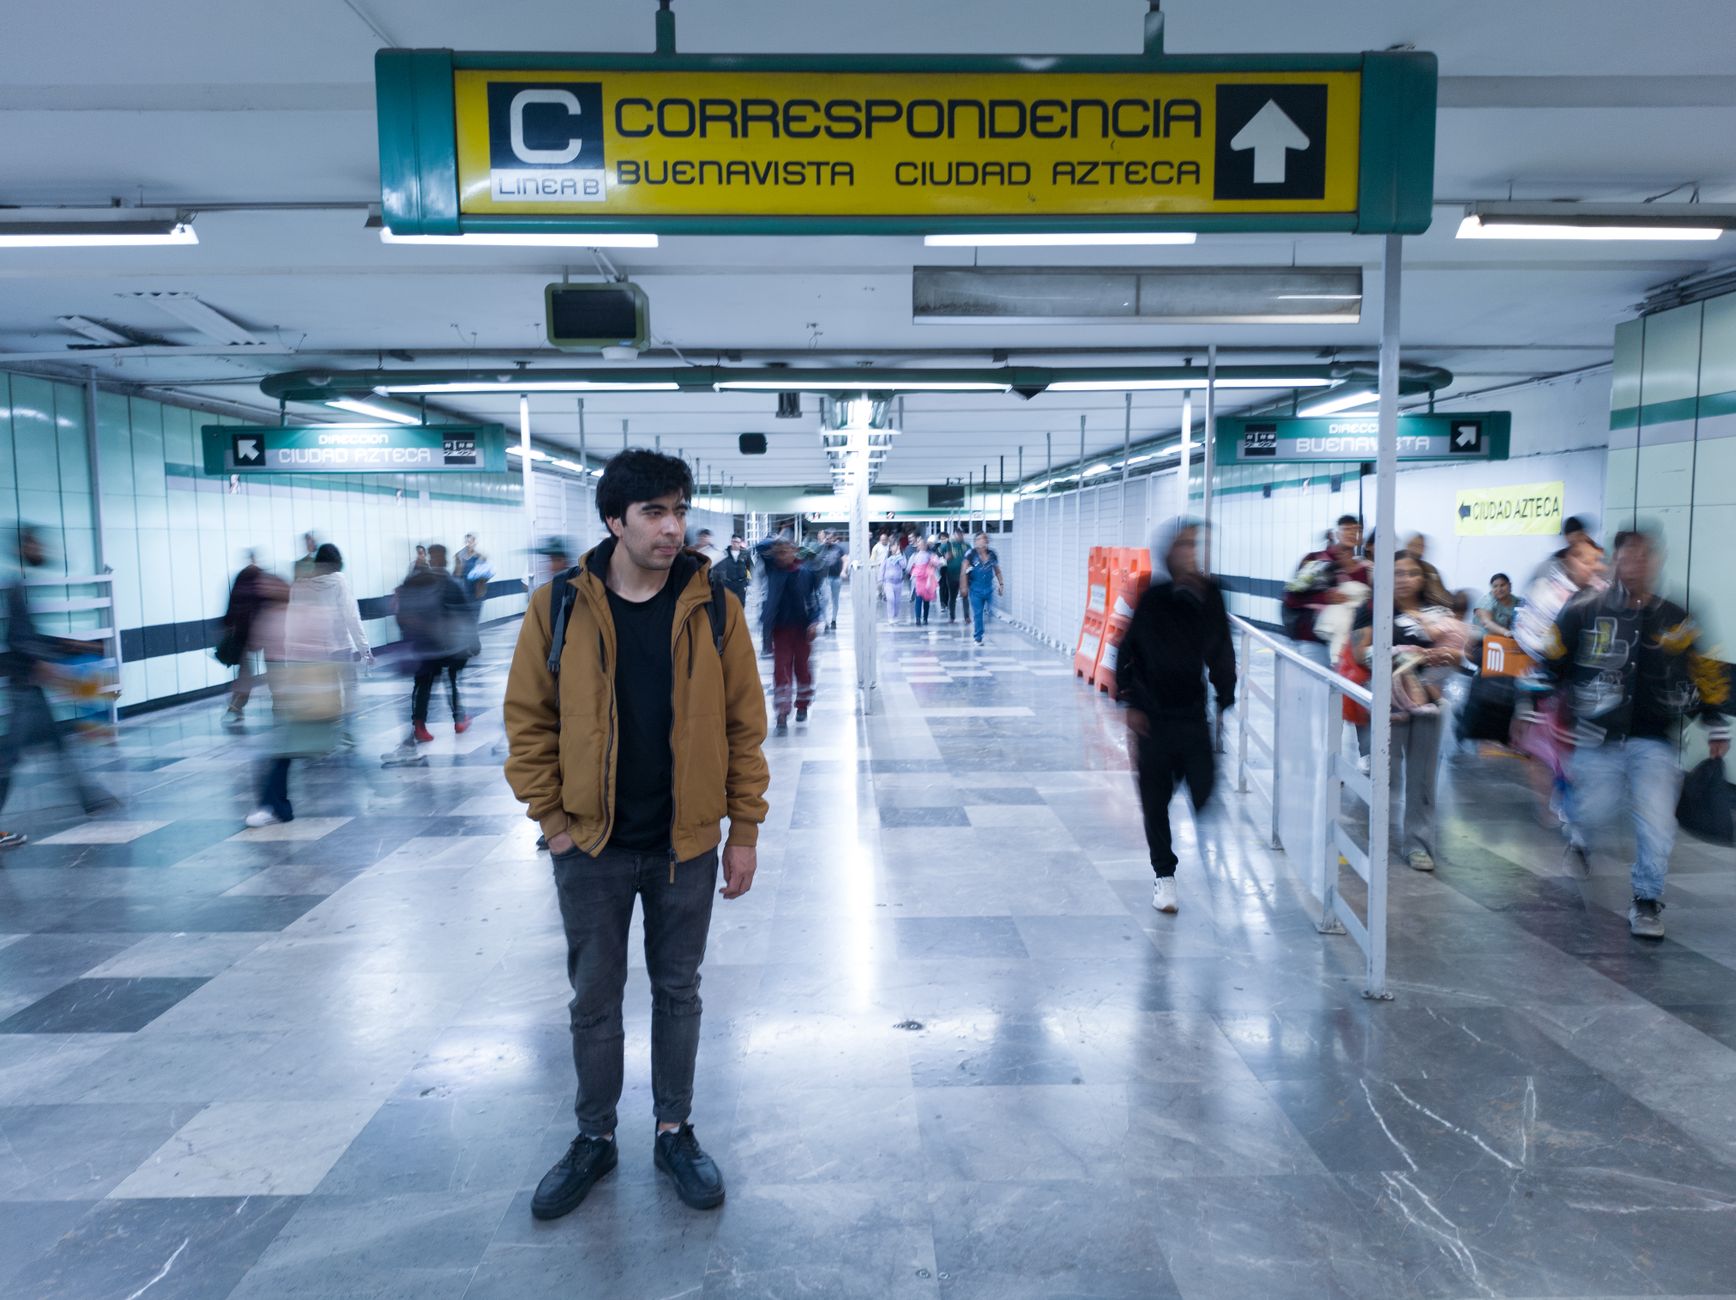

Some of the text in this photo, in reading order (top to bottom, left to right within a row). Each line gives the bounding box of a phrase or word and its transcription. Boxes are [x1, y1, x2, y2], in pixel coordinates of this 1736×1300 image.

[510, 88, 582, 165] C
[615, 97, 1202, 139] CORRESPONDENCIA
[617, 160, 1201, 186] BUENAVISTA CIUDAD AZTECA
[498, 176, 600, 196] LINEA B
[1328, 423, 1379, 434] DIRECC
[1296, 435, 1430, 453] BUENAVSTA
[278, 447, 431, 464] CIUDAD AZTECA
[1472, 496, 1560, 520] CIUDAD AZTECA
